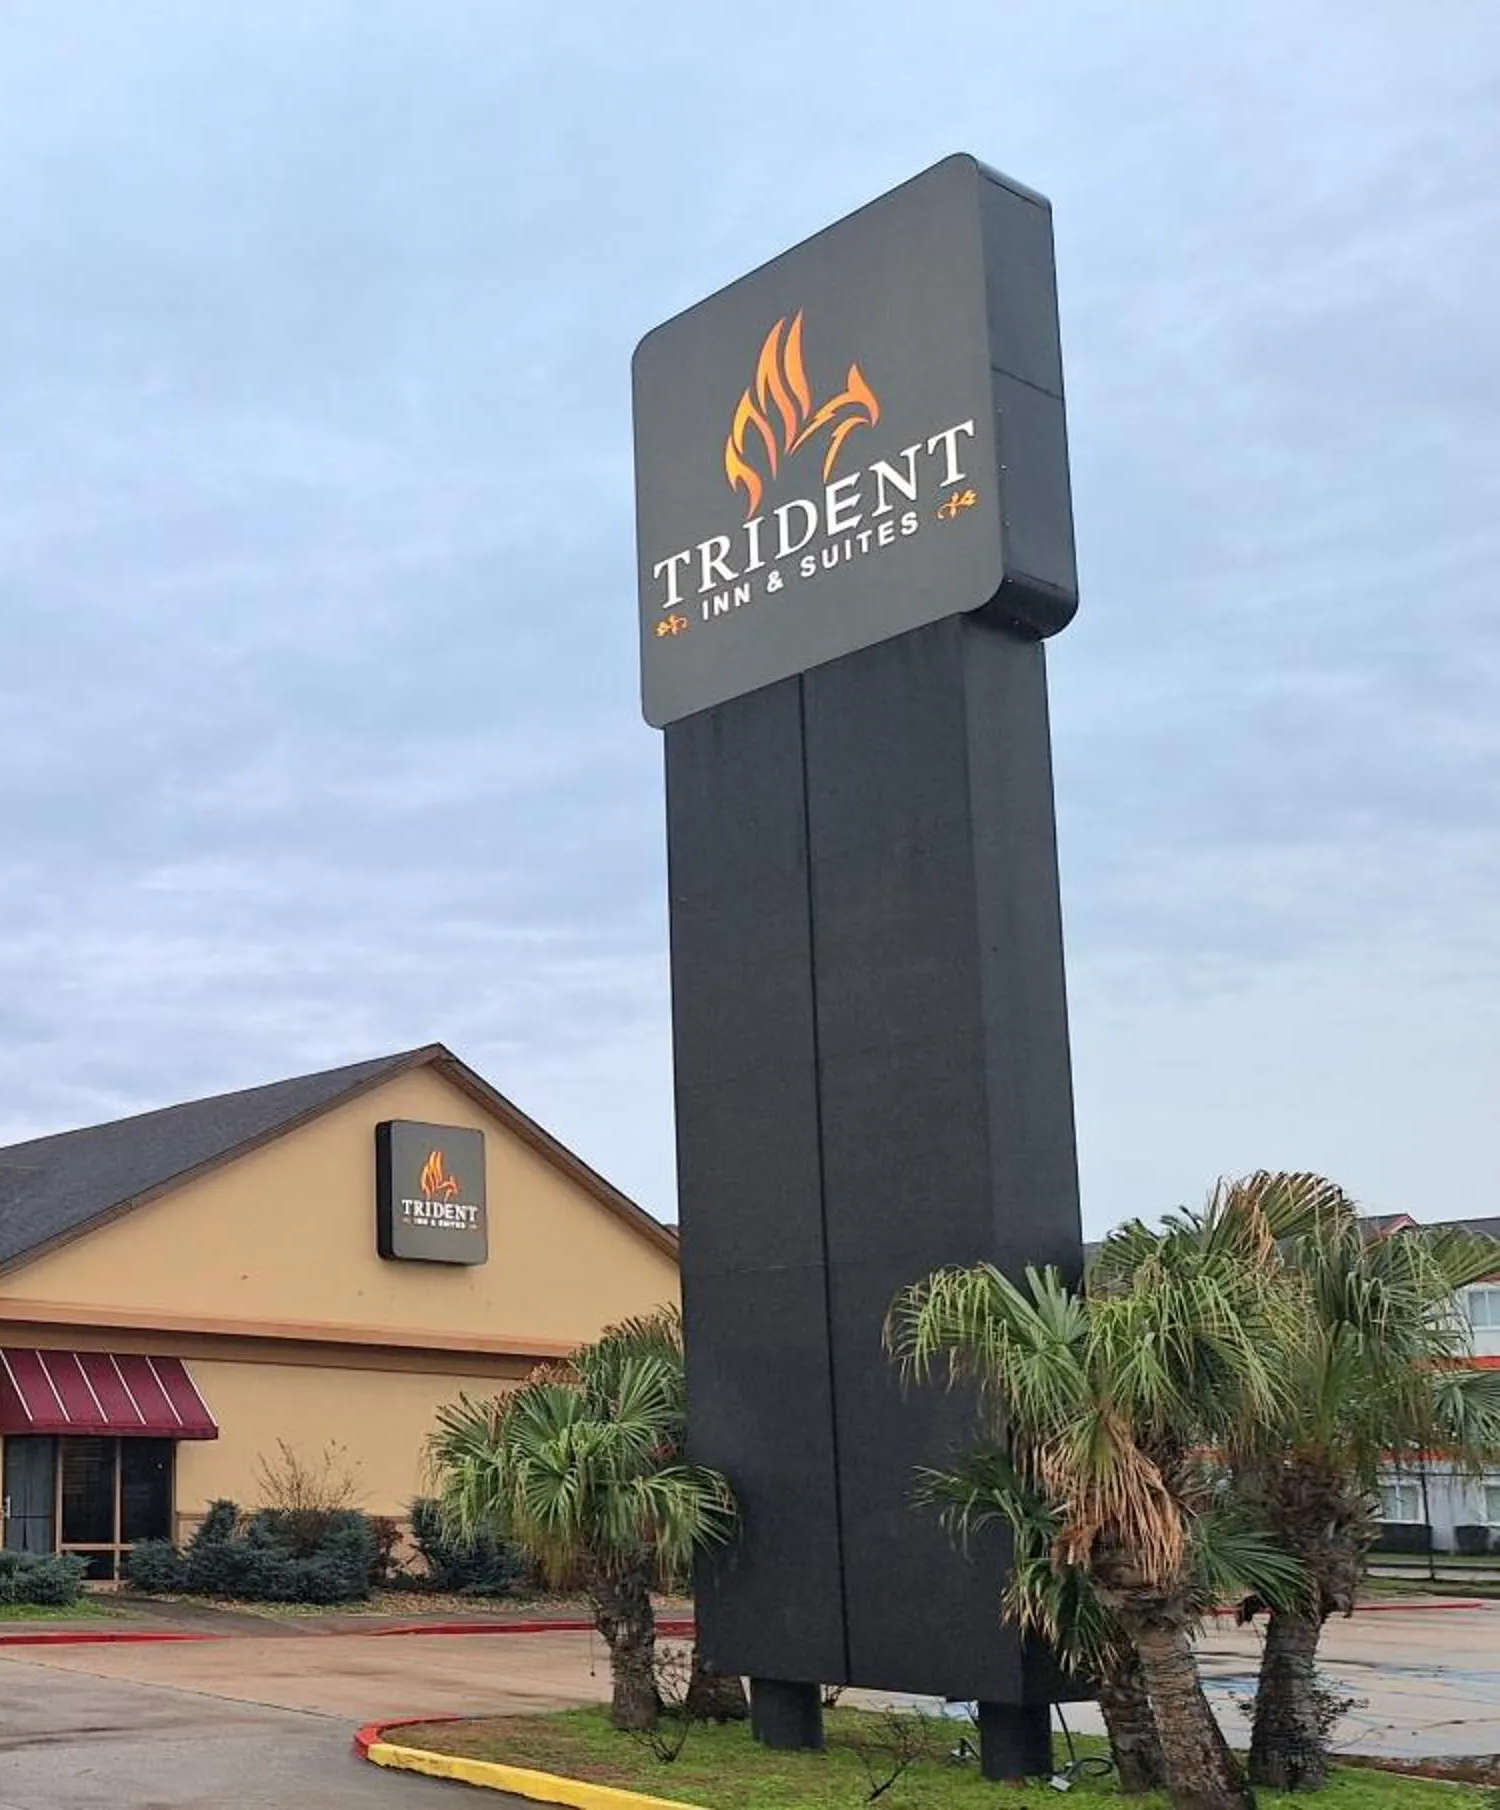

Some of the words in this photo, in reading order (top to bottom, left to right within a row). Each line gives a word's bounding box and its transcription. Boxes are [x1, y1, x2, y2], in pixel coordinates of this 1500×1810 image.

[653, 420, 975, 609] TRIDENT
[703, 583, 750, 620] INN
[767, 570, 784, 593] &
[800, 512, 919, 578] SUITES
[401, 1199, 478, 1222] TRIDENT
